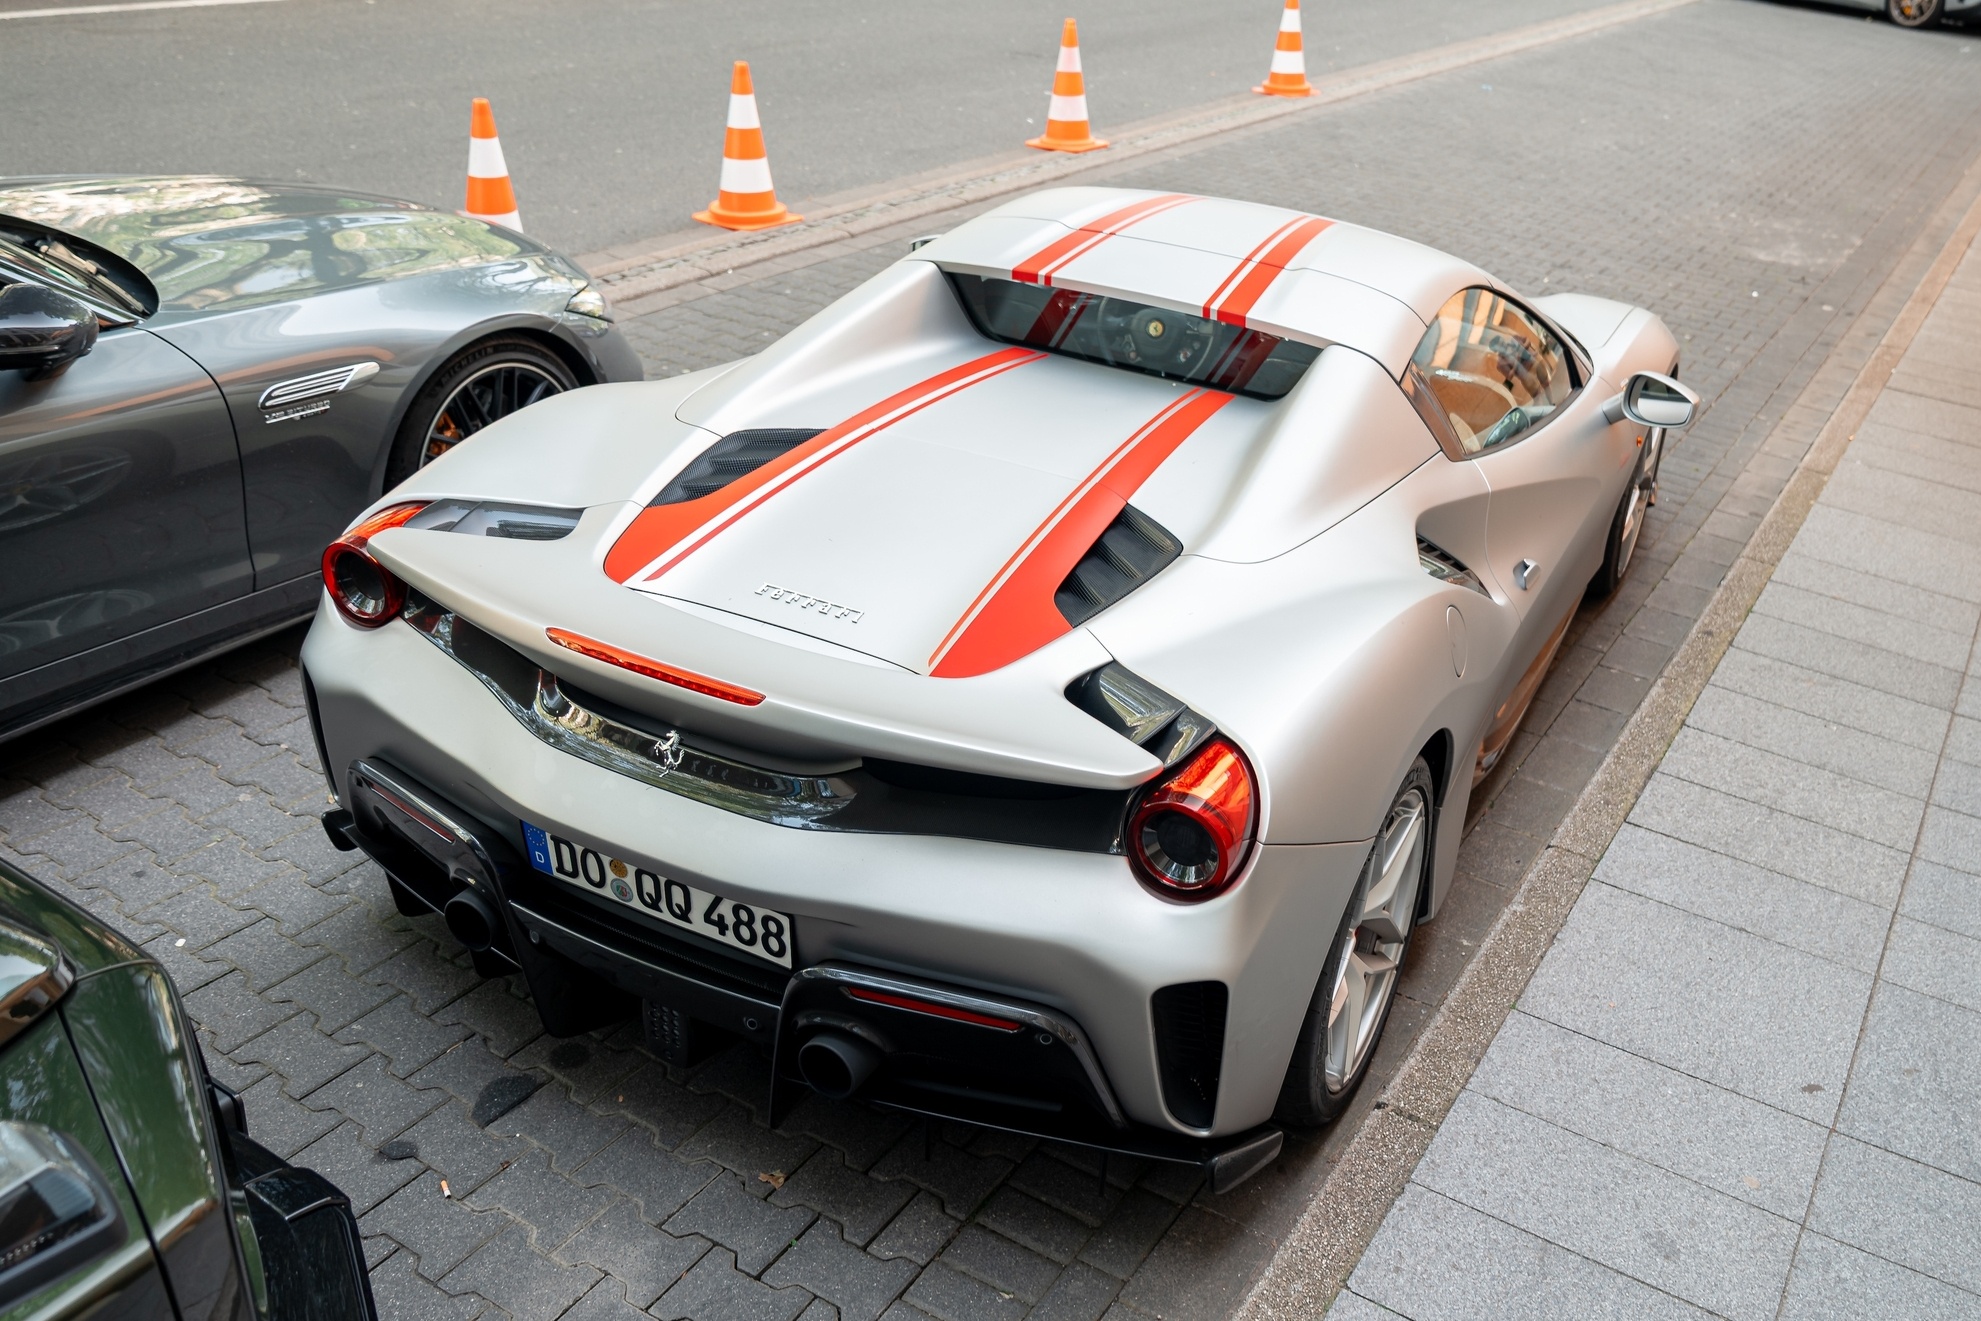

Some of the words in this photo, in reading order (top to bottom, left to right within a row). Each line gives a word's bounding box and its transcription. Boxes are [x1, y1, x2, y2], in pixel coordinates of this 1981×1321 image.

[441, 346, 495, 385] MICHELIN
[754, 582, 865, 624] Ferrari
[535, 851, 545, 863] D
[550, 834, 606, 889] DO
[635, 867, 693, 924] QQ
[703, 895, 787, 958] 488
